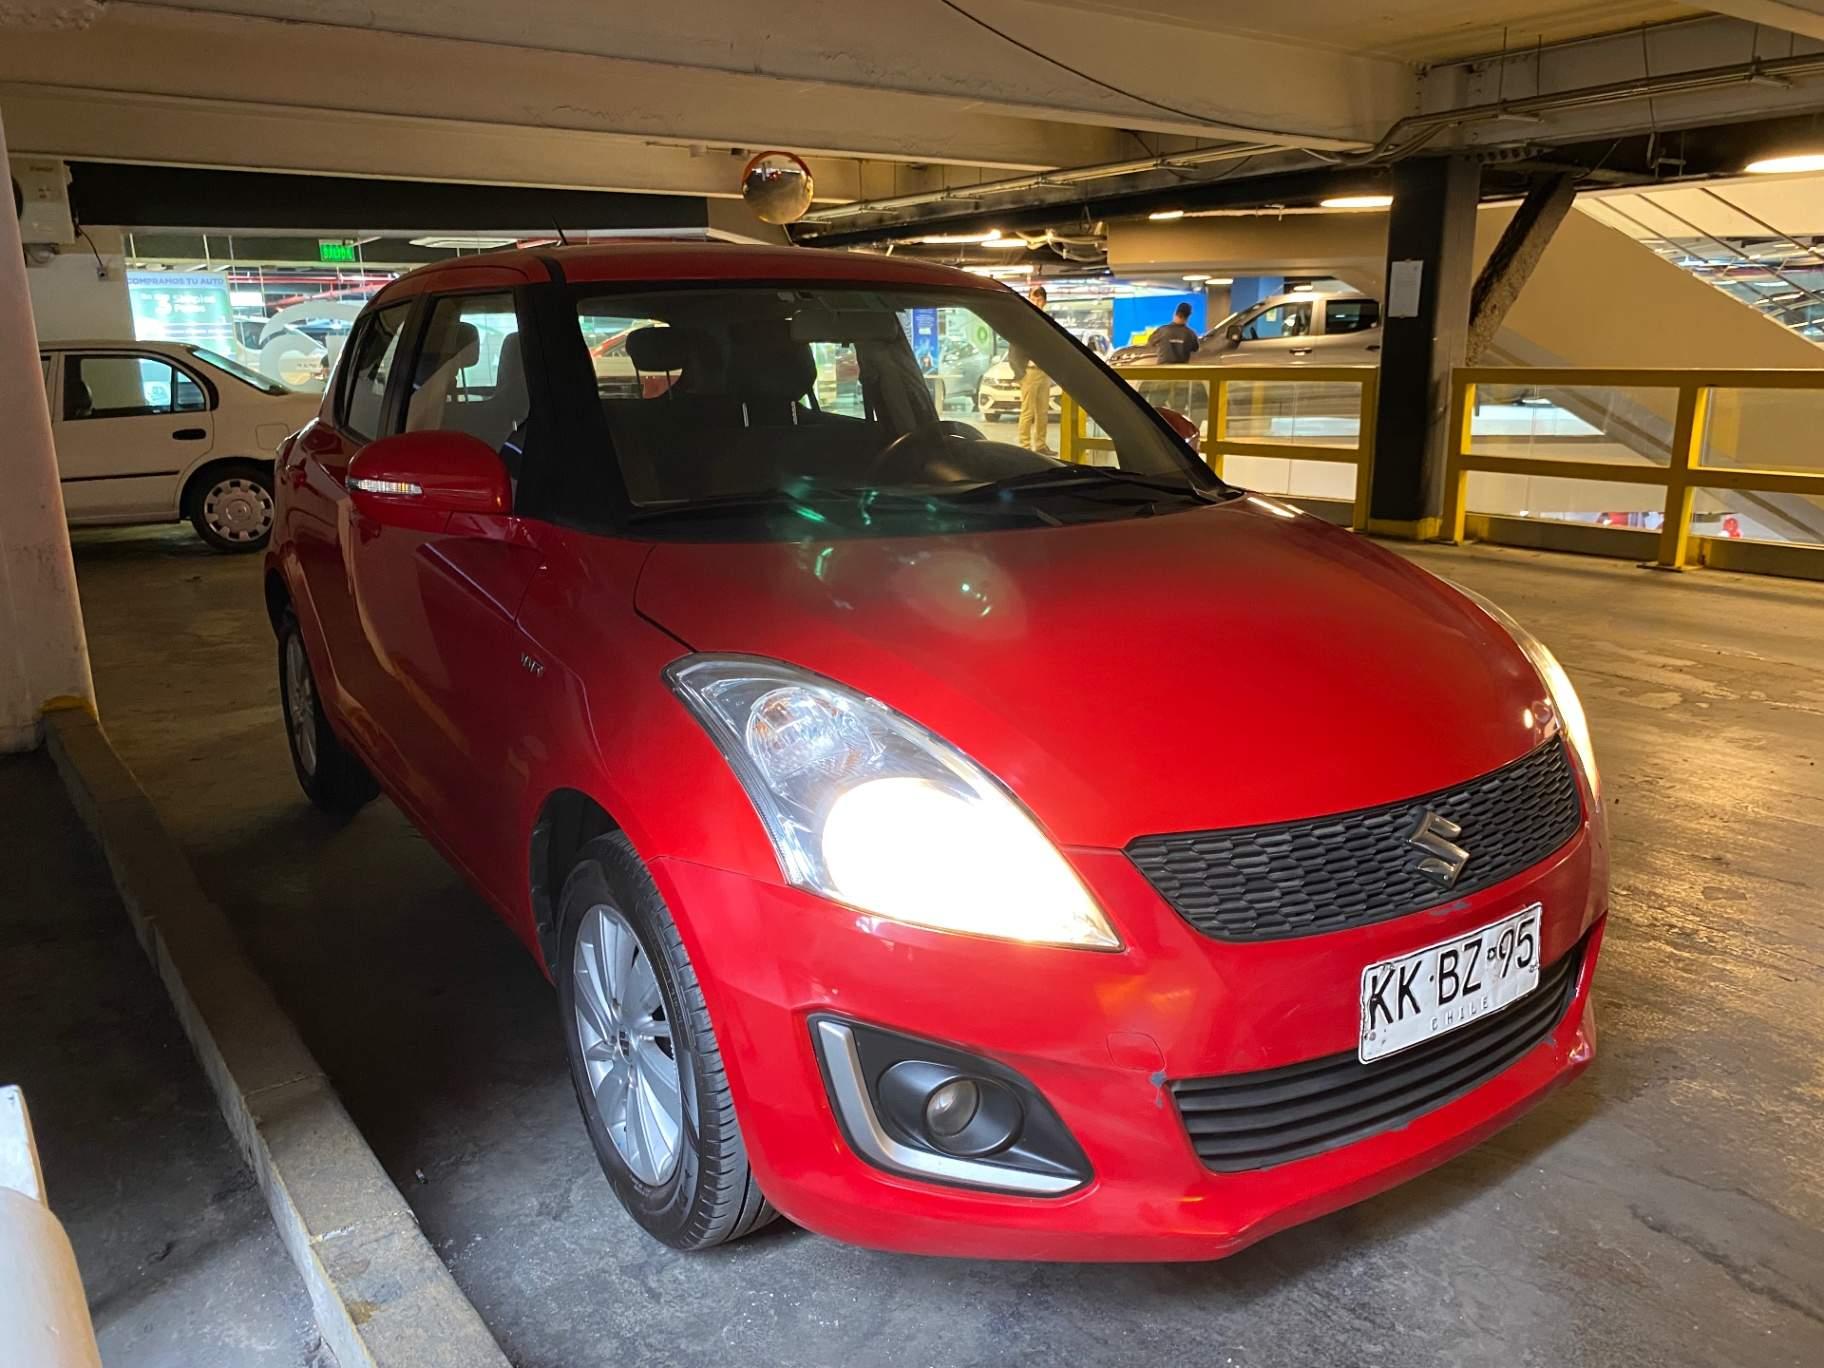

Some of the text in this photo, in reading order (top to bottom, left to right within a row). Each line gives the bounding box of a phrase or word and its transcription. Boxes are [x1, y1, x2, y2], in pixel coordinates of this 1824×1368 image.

[186, 278, 199, 286] TU
[201, 278, 224, 286] AUTO
[1431, 996, 1489, 1031] CHILE
